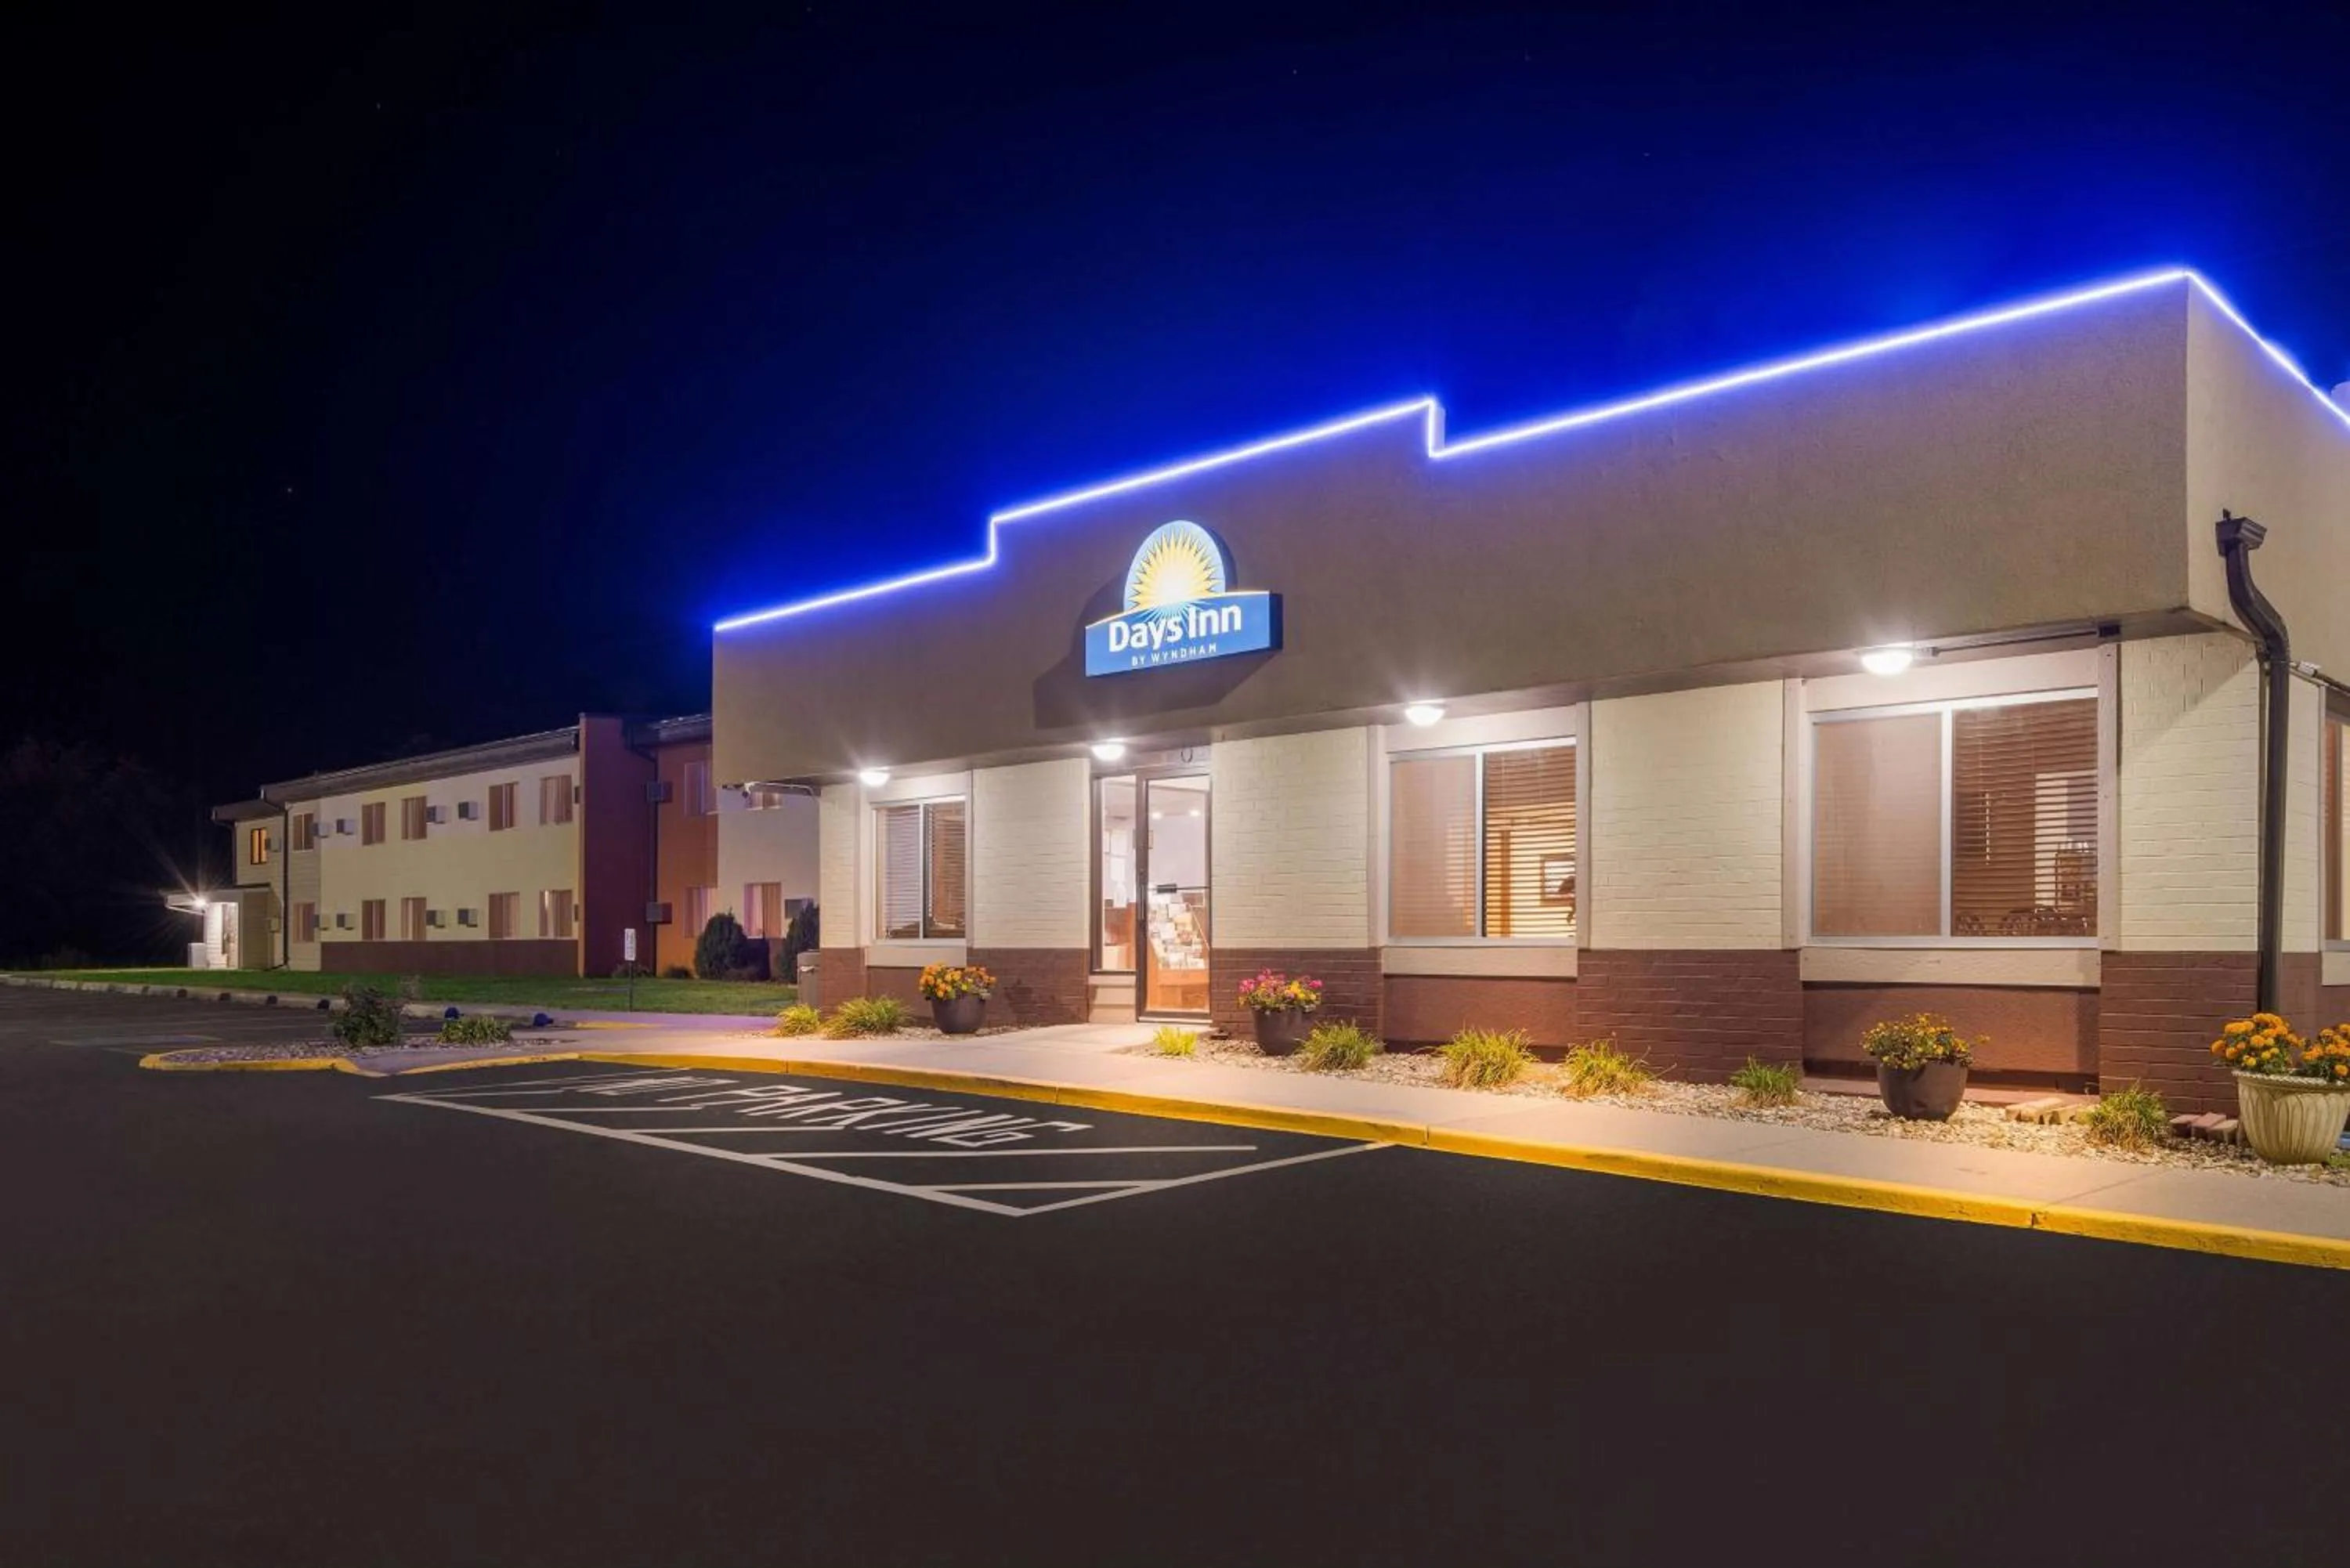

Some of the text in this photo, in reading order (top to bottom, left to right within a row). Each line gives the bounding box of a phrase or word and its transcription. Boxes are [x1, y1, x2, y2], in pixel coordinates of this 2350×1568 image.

[1108, 604, 1242, 652] Days Inn
[1131, 642, 1217, 667] BY WYNDHAM
[655, 1084, 1094, 1147] PARKING
